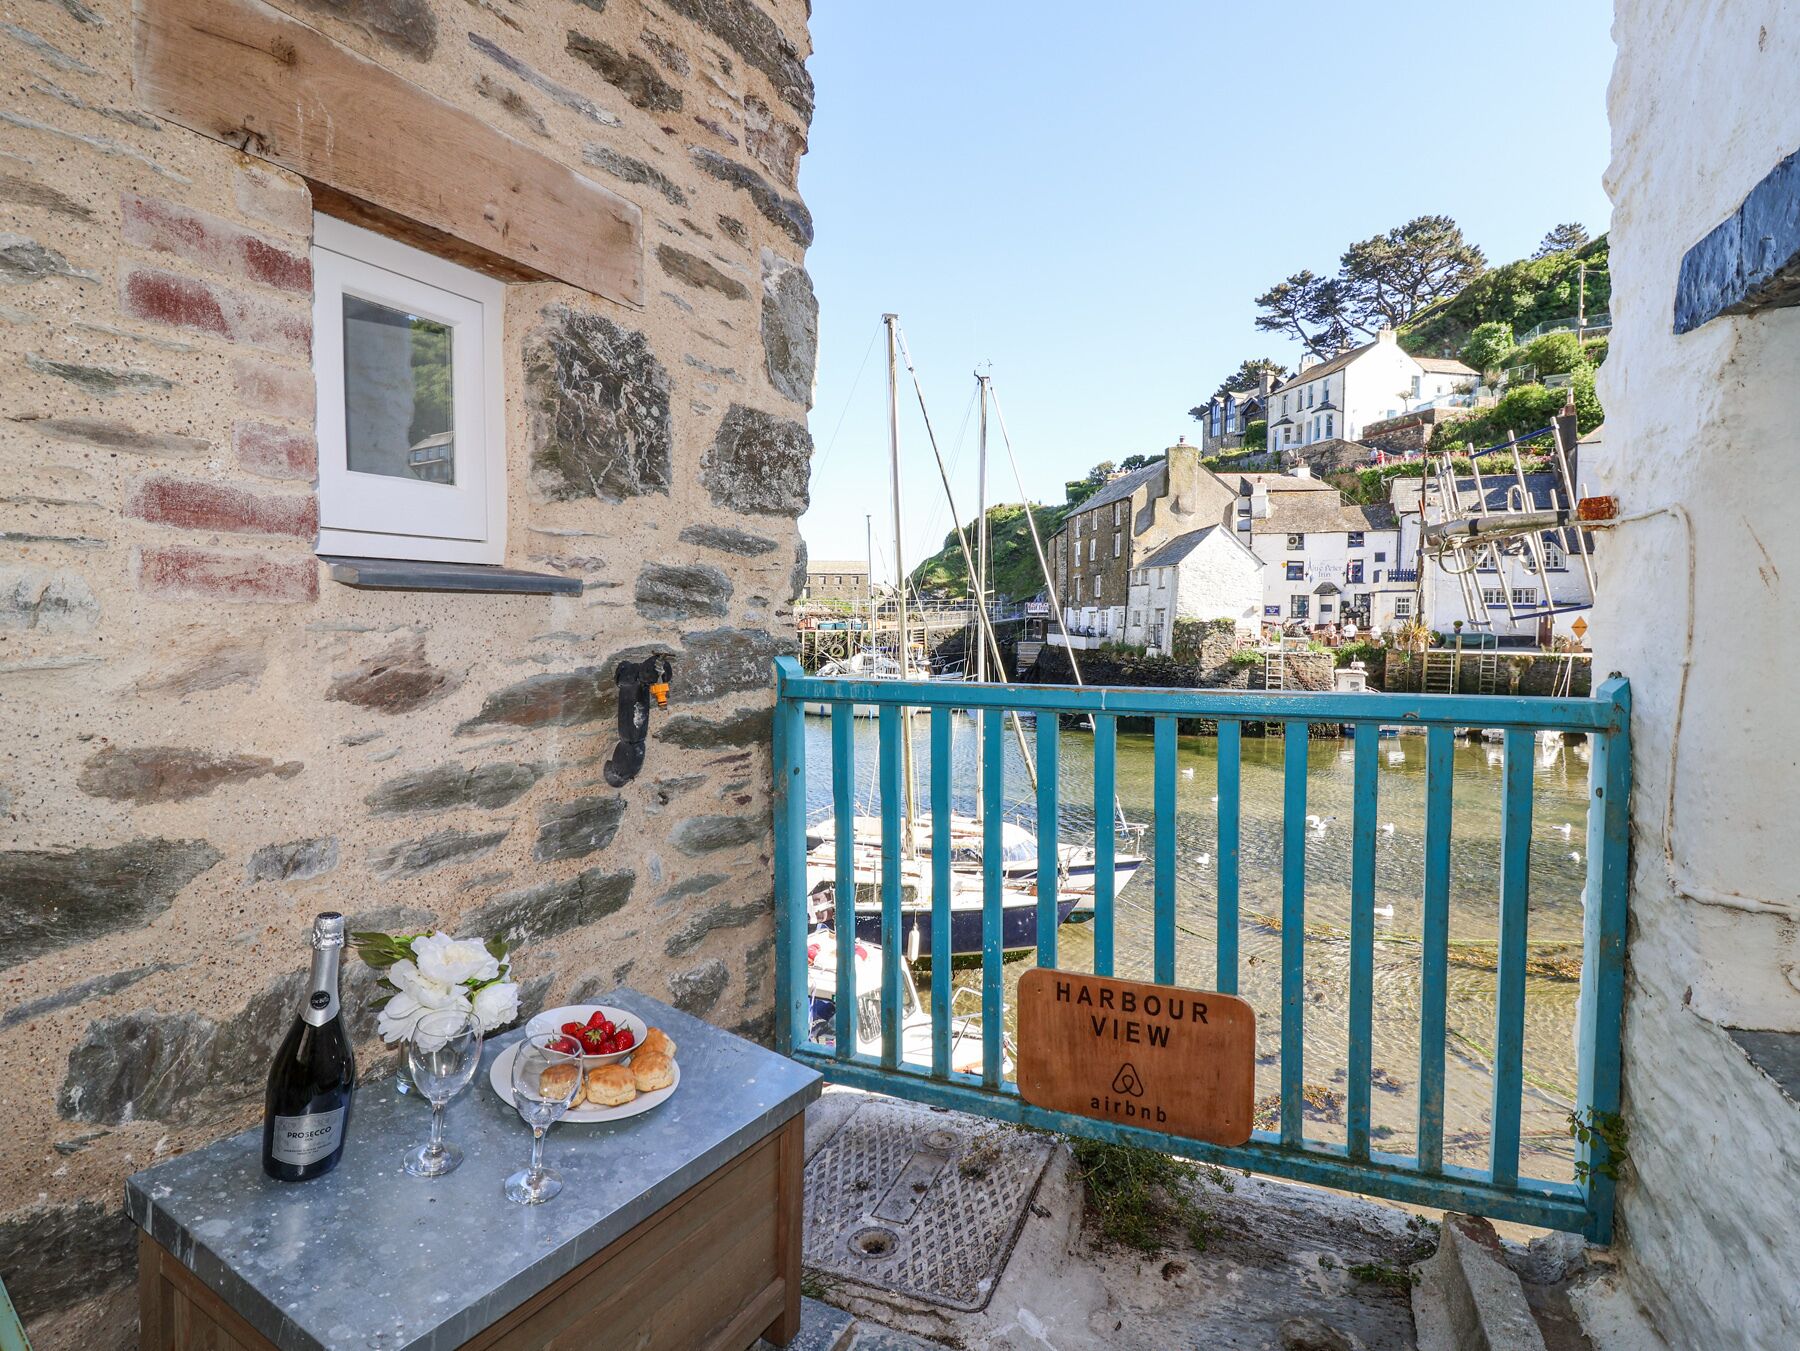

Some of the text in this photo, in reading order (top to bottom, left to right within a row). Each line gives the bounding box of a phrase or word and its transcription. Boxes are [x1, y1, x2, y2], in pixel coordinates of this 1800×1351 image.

[1056, 981, 1209, 1024] HARBOUR
[1091, 1015, 1170, 1048] VIEW
[1090, 1096, 1167, 1123] airbnb
[287, 1126, 332, 1139] PROSECCO
